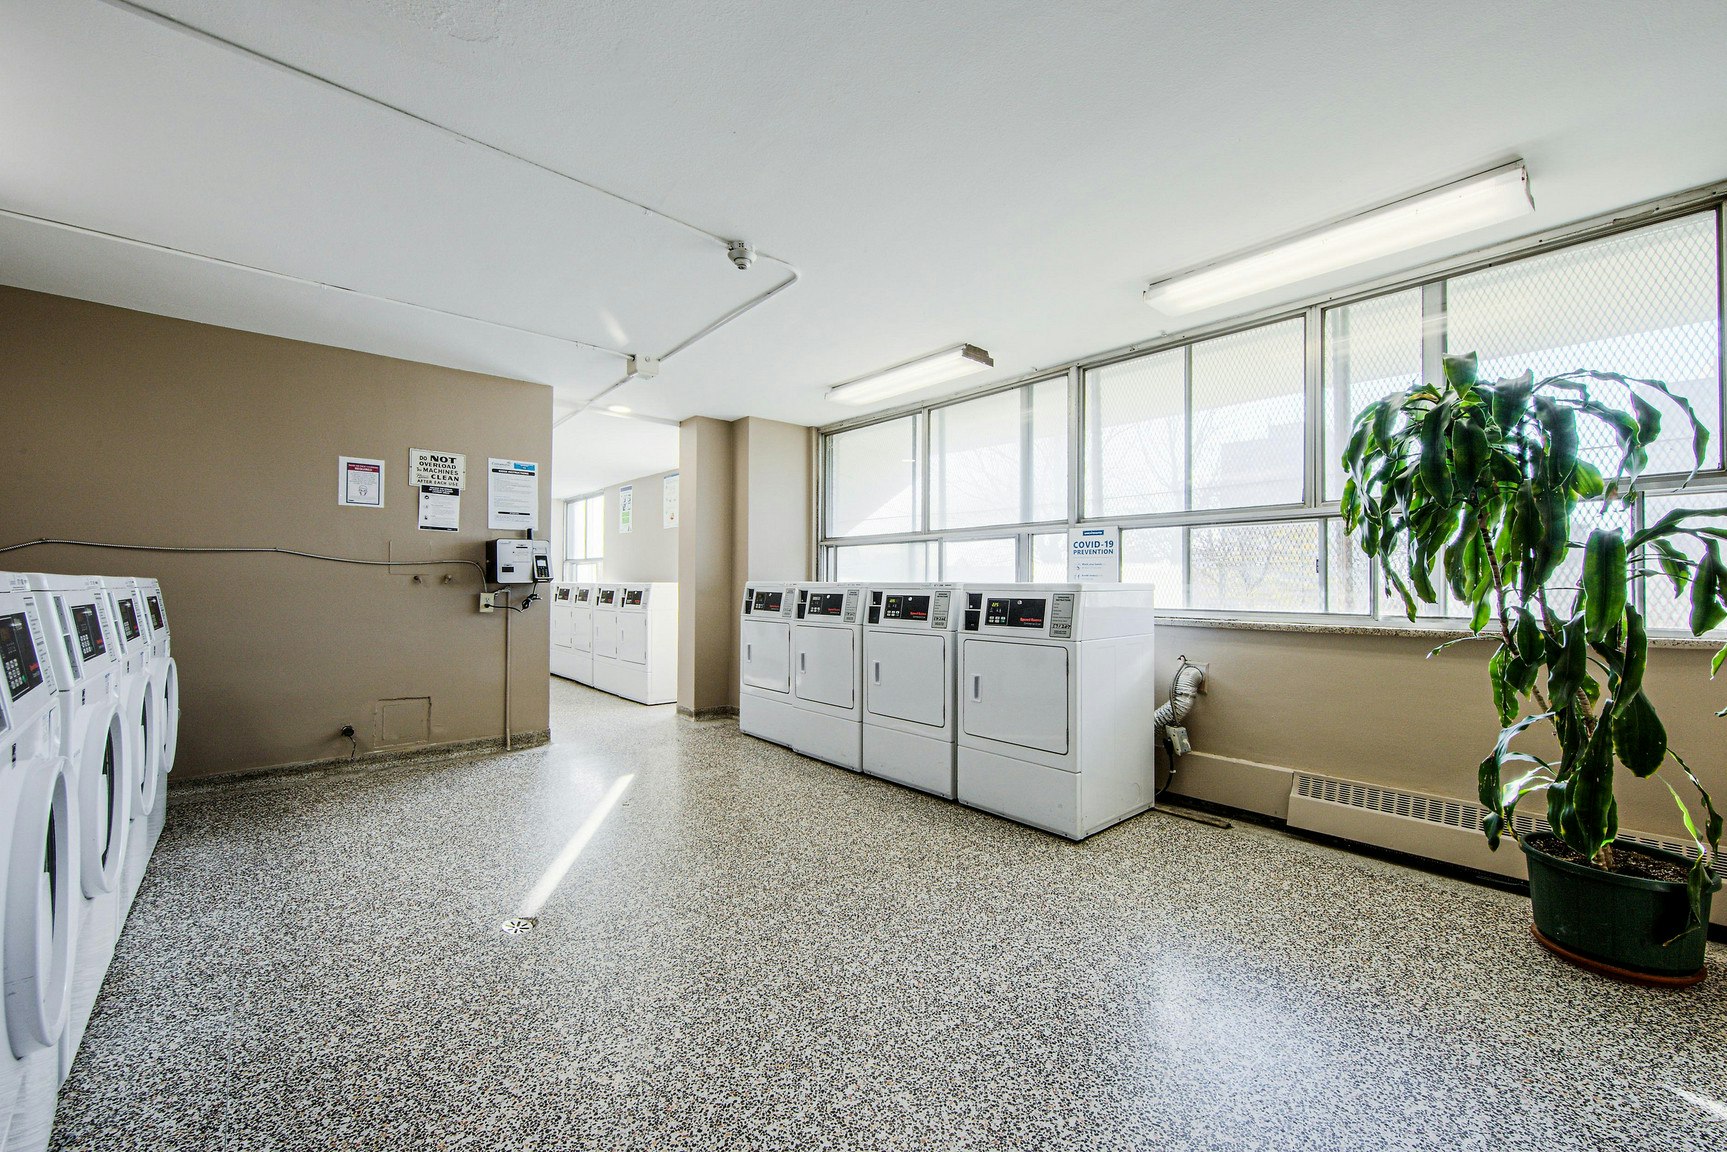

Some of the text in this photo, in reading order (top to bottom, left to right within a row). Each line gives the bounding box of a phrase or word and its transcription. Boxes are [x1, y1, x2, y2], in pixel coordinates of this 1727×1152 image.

[430, 455, 456, 464] NOT
[419, 461, 456, 469] OVERLOAD
[1073, 540, 1114, 549] COVID-19
